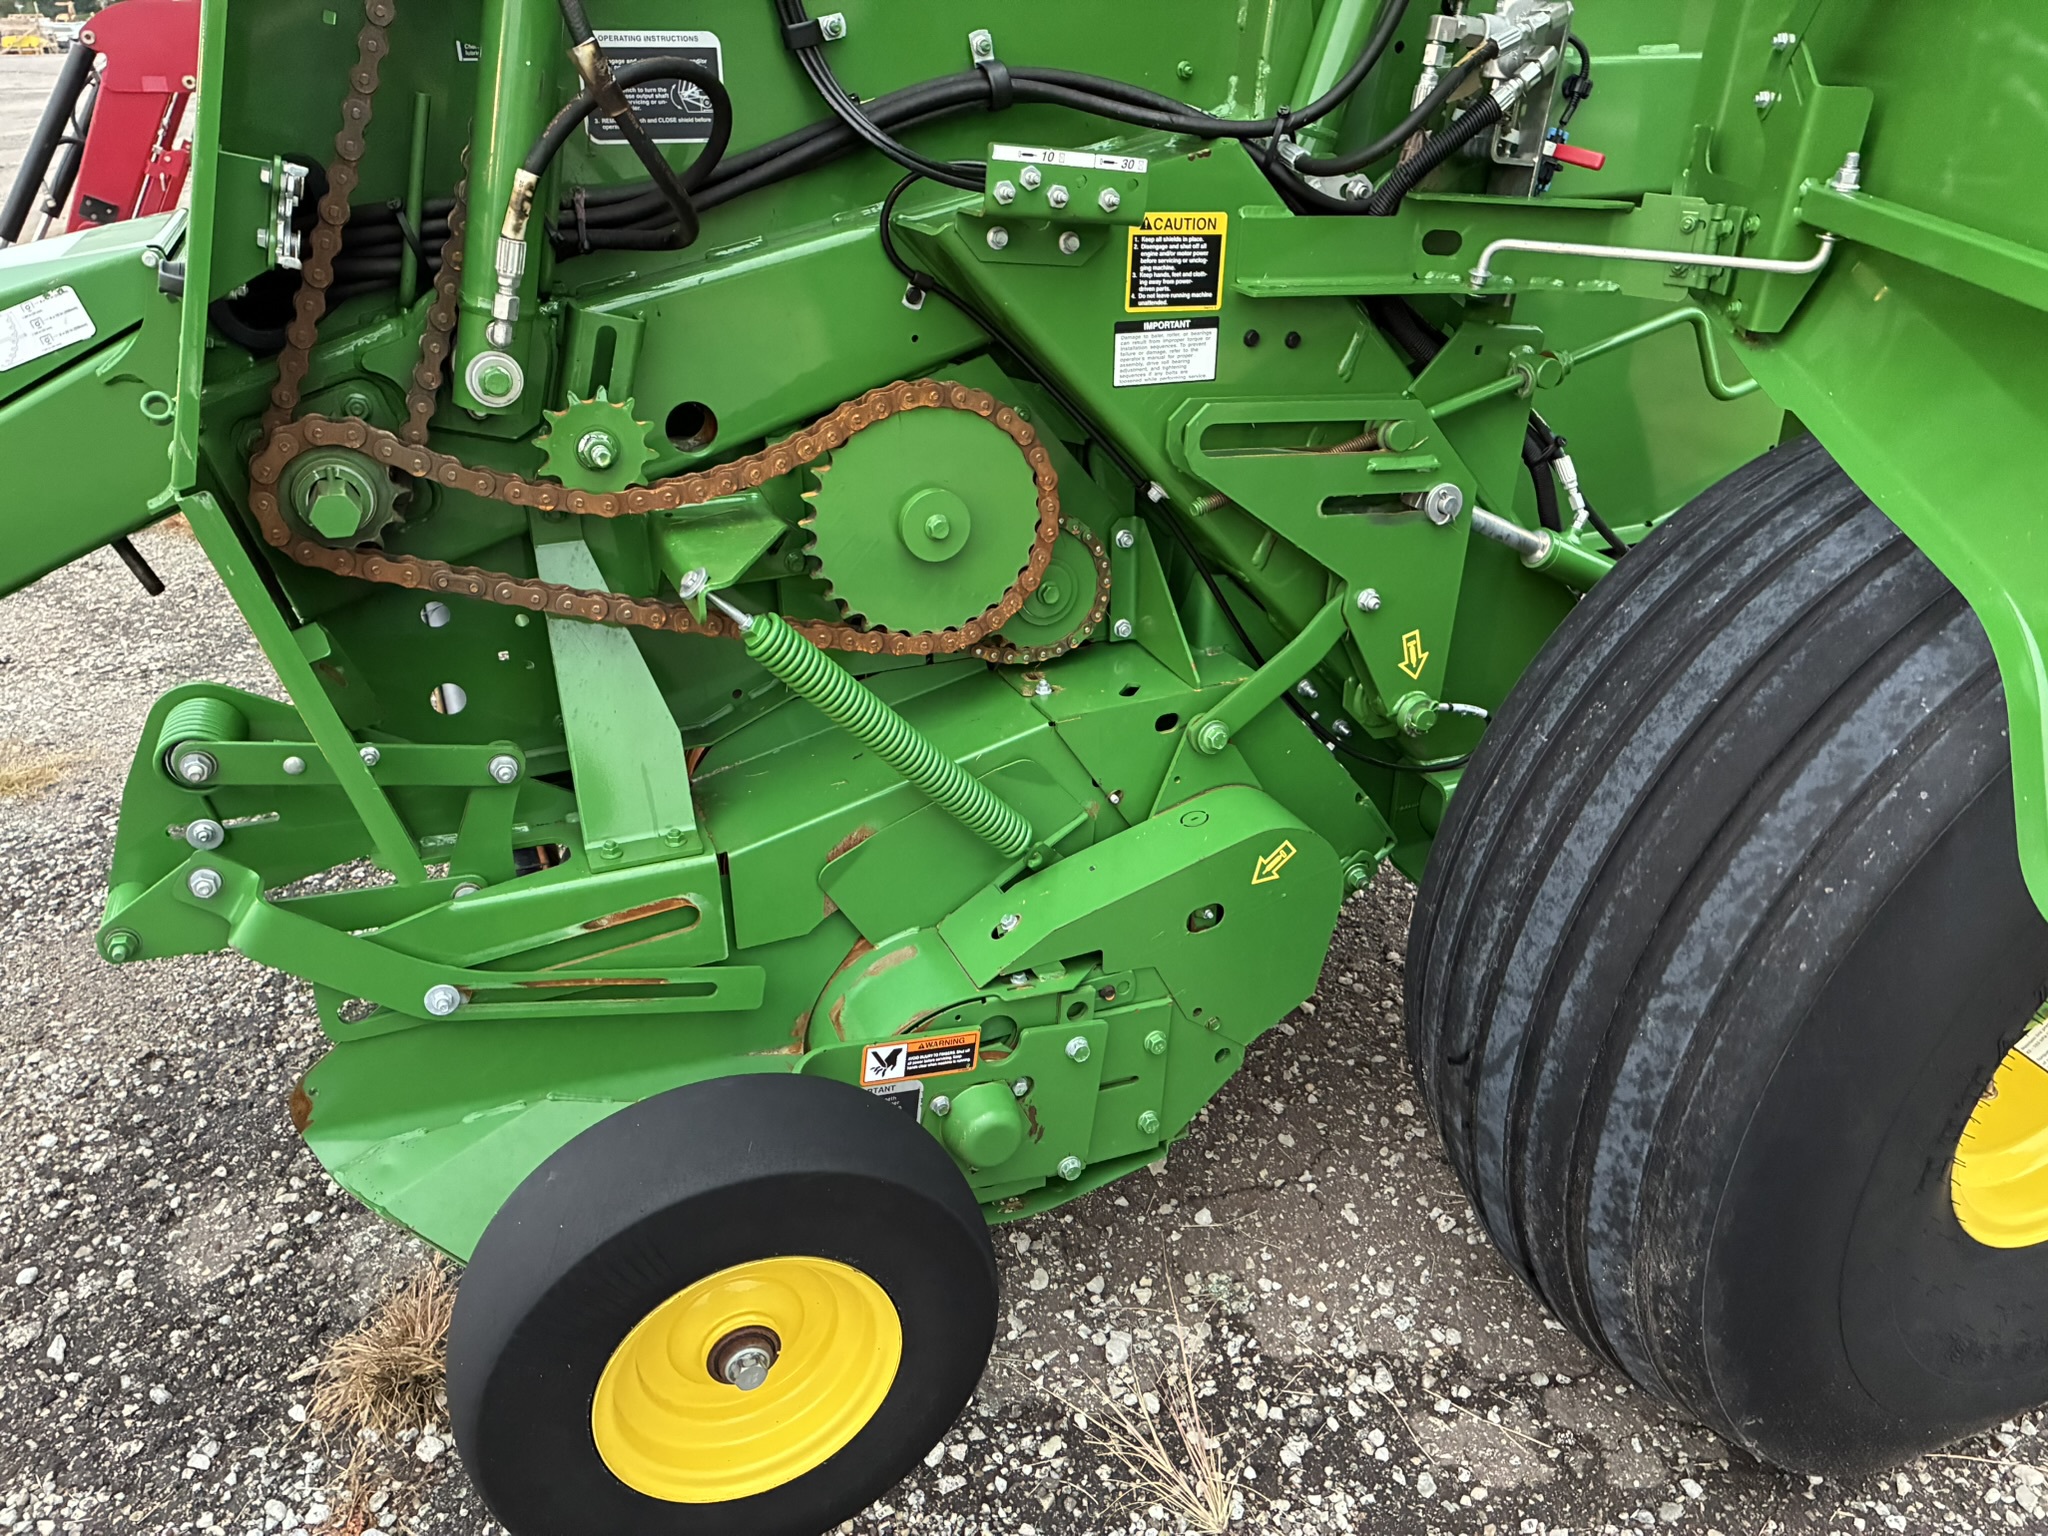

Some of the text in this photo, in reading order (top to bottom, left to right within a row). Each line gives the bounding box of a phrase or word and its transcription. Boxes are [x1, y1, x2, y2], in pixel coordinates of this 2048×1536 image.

[1042, 151, 1054, 162] 10
[1121, 159, 1135, 169] 30
[1154, 217, 1217, 230] CAUTION
[1144, 320, 1191, 330] IMPORTANT
[925, 1037, 965, 1049] WARNING
